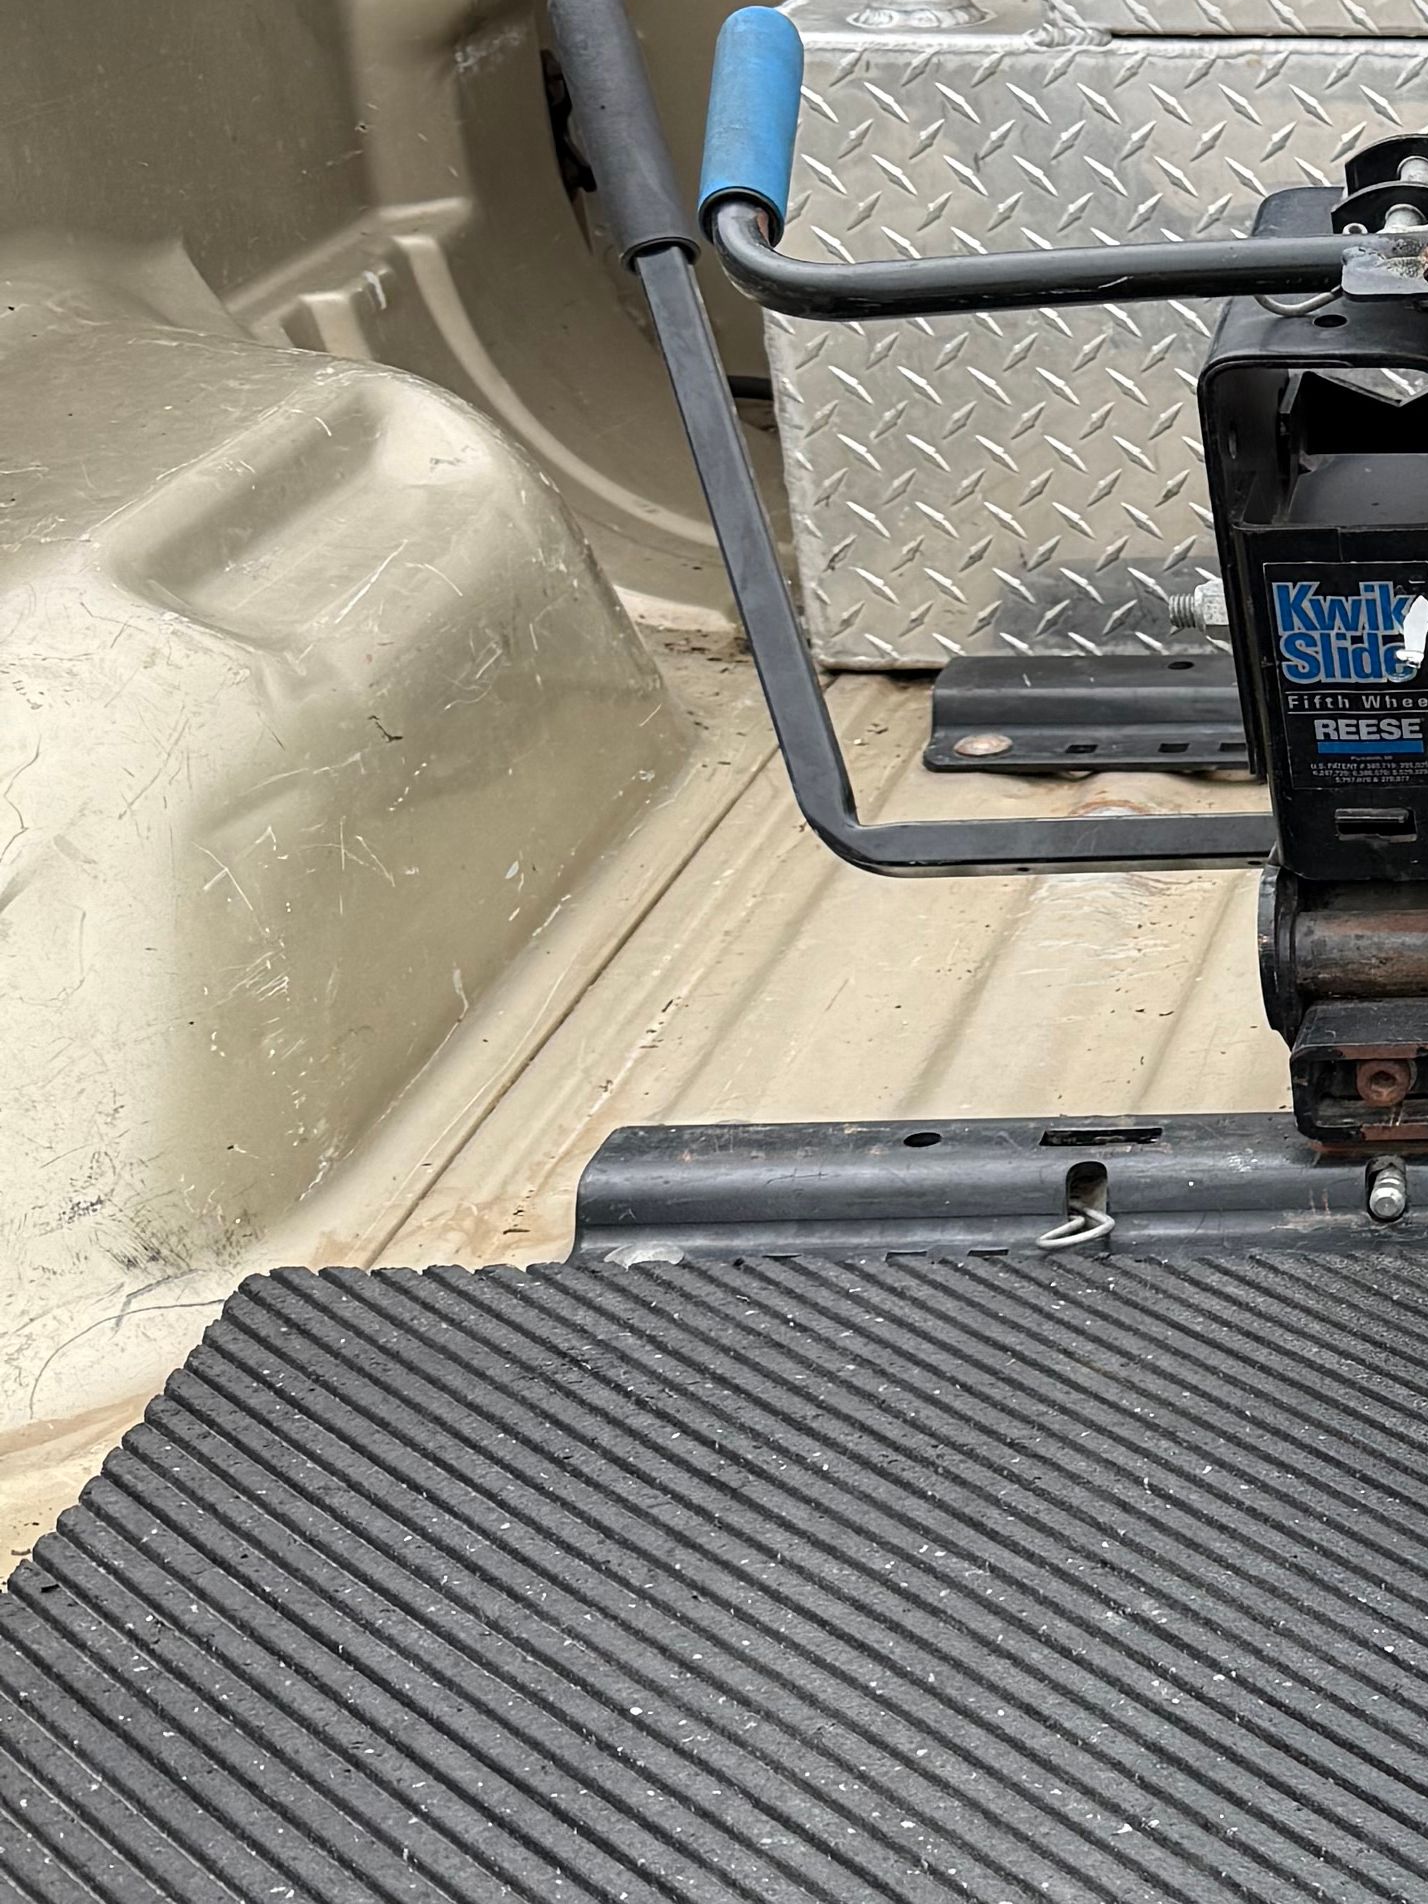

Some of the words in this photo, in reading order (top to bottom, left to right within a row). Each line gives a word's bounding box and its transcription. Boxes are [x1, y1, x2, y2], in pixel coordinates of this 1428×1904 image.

[1279, 630, 1418, 684] Slide
[1287, 695, 1350, 709] Fifth
[1314, 718, 1423, 740] REESE
